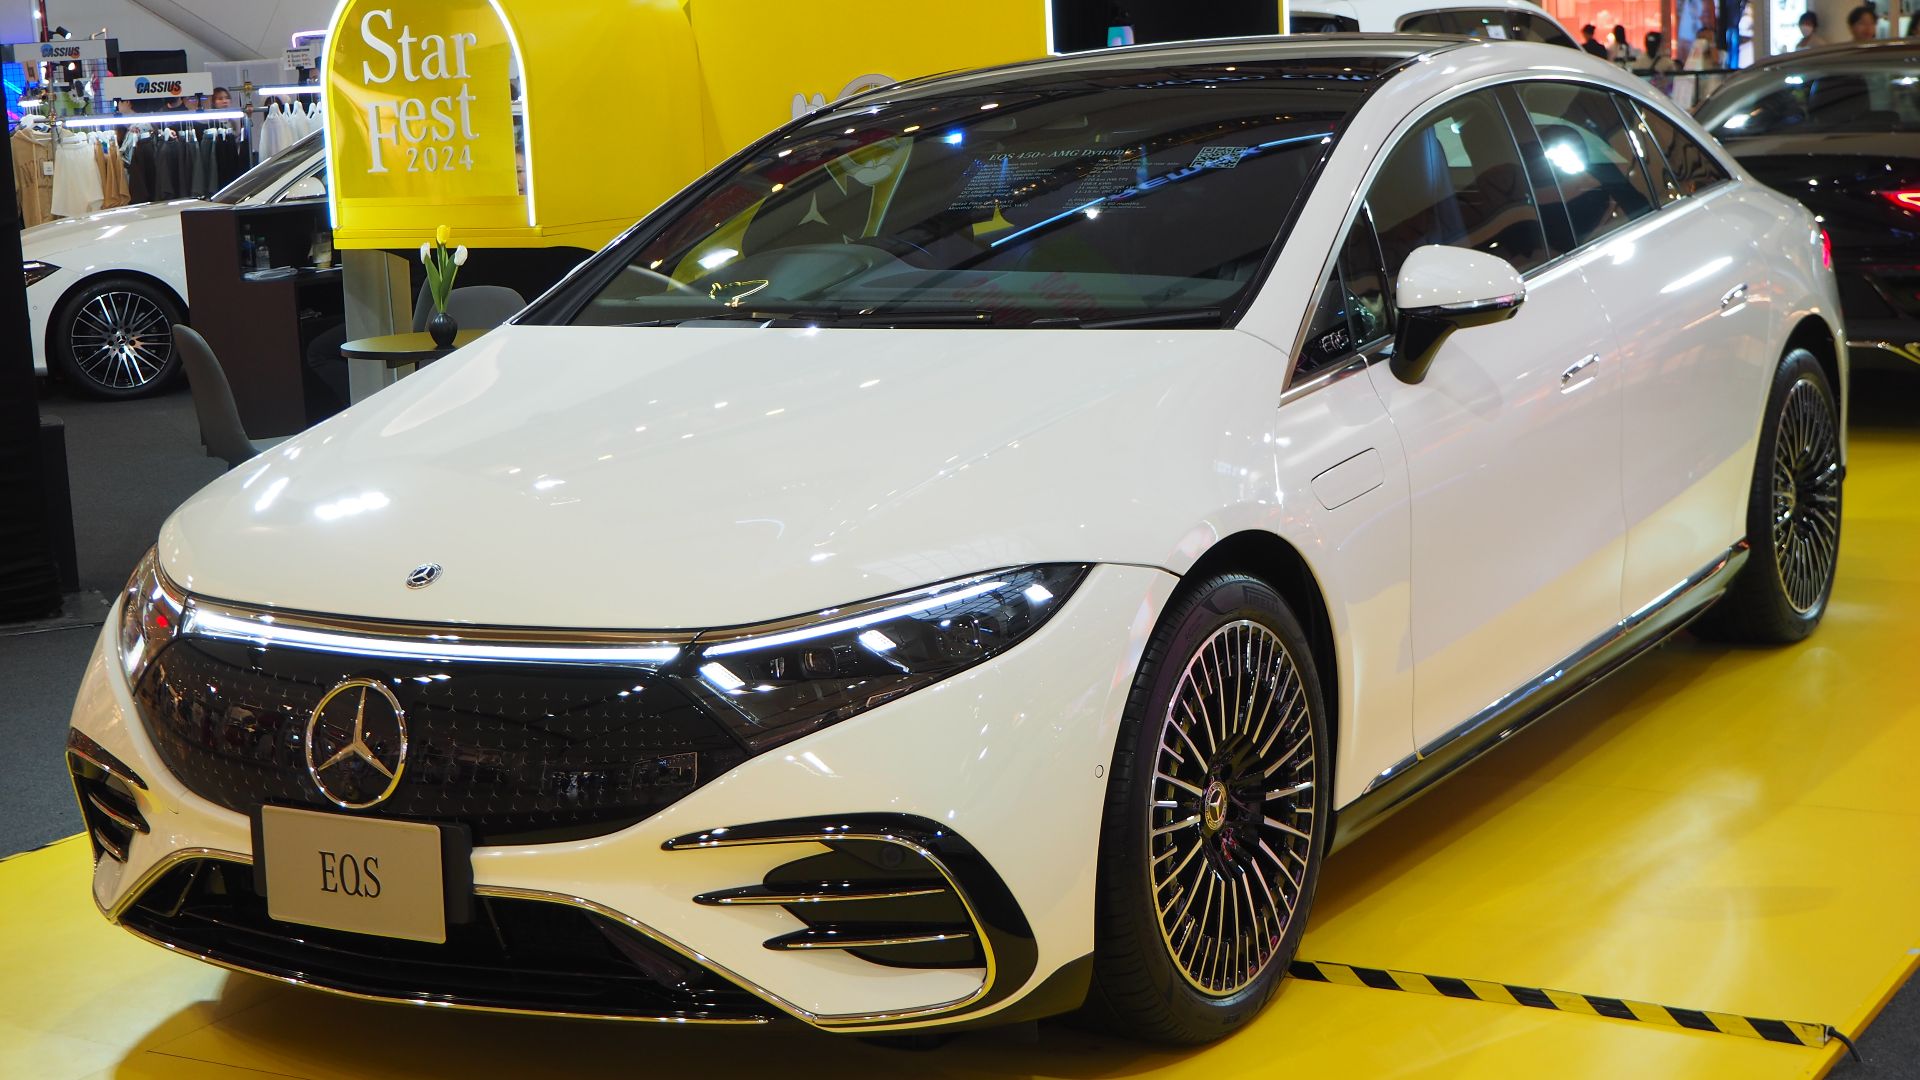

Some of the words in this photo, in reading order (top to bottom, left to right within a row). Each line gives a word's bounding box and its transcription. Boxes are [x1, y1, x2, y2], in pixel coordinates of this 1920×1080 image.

[41, 46, 80, 58] CASSIUS
[361, 9, 477, 85] Star
[136, 80, 182, 95] CASSIUS
[367, 83, 480, 174] Fest
[407, 144, 474, 173] 2024
[1016, 151, 1046, 159] 450+
[1047, 149, 1080, 158] AMG
[318, 850, 381, 898] EQS
